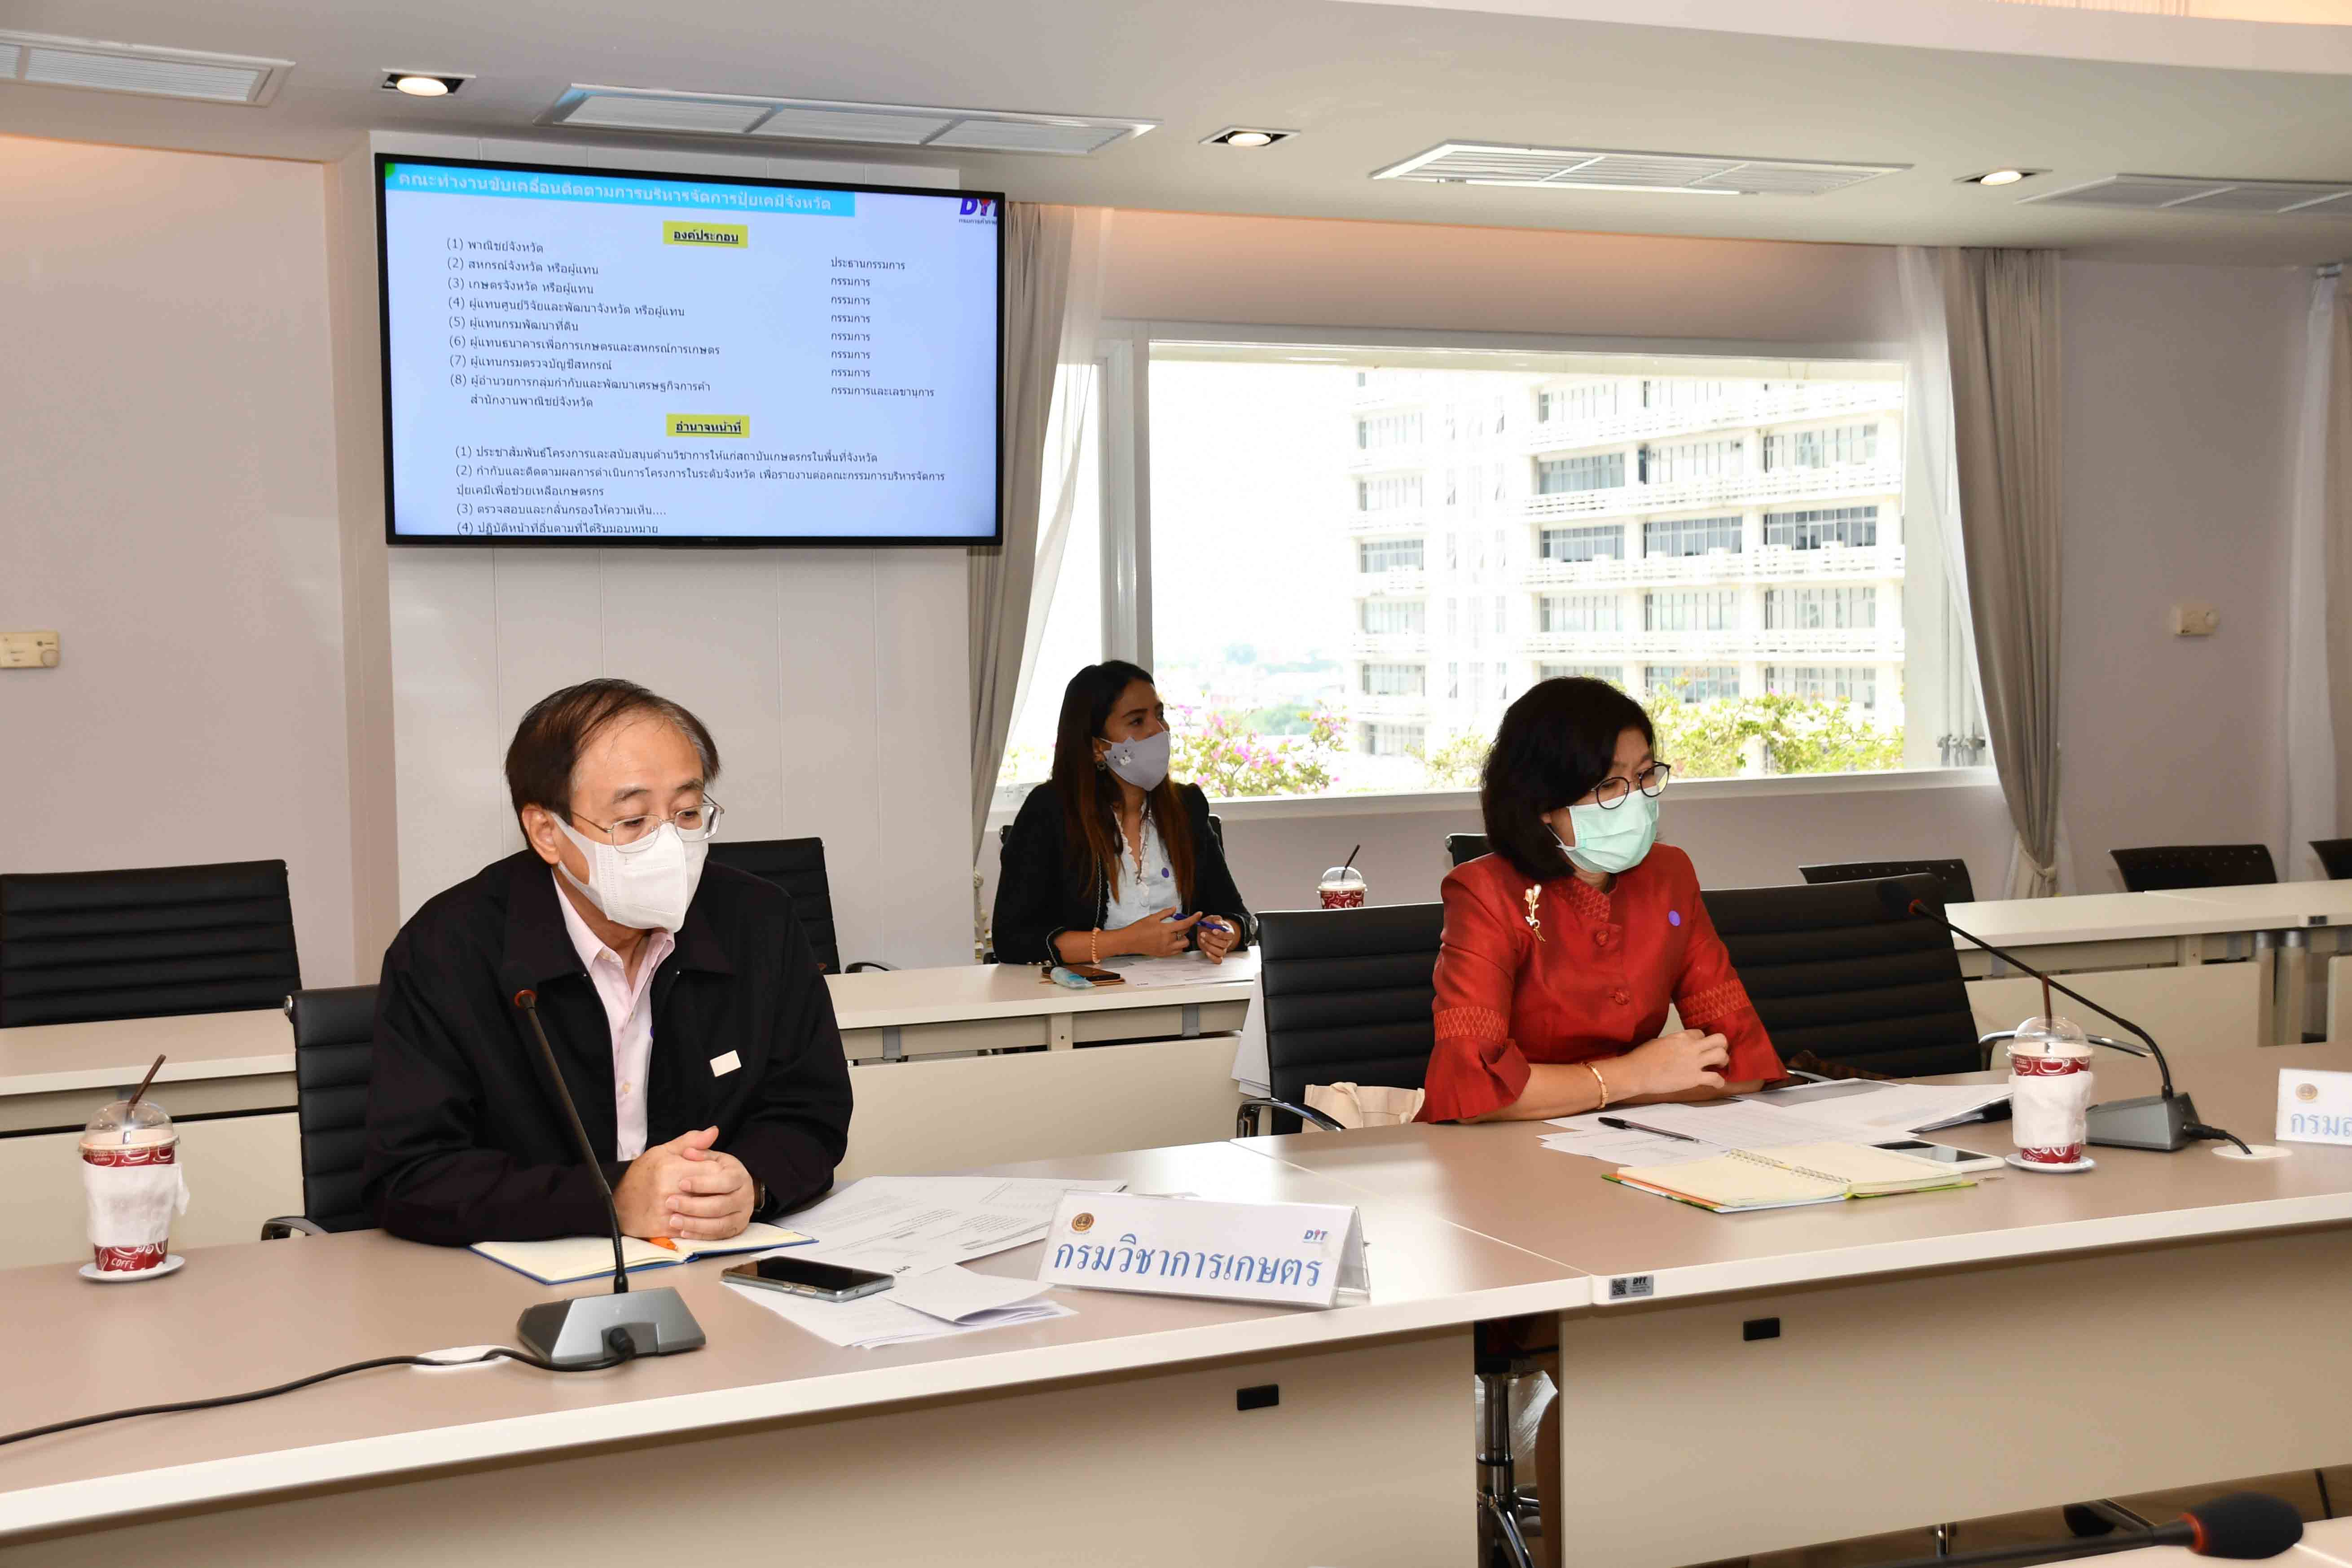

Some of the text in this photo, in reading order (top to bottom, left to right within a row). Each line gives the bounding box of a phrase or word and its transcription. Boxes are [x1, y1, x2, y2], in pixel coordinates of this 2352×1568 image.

[673, 229, 739, 244] องค์ประกอบ
[447, 237, 544, 254] (1) พาณิชย์จังหวัด
[447, 257, 598, 277] (2) สหกรณ์จังหวัด หรือผู้แทน
[831, 256, 906, 270] ประธานกรรมการ
[448, 277, 593, 295] (3) เกษตรจังหวัด หรือผู้แทน
[831, 277, 870, 287] กรรมการ
[448, 297, 685, 318] (4) ผู้แทนศูนย์วิจัยและพัฒนาจังหวัด หรือผู้แทน
[831, 296, 871, 306] กรรมการ
[449, 316, 579, 331] (5) ผู้แทนกรมพัฒนาที่ดิน
[831, 314, 870, 324] กรรมการ
[449, 334, 720, 355] (6) ผู้แทนธนาคารเพื่อการเกษตรและสหกรณ์การเกษตร
[831, 333, 870, 342] กรรมการ
[450, 354, 612, 371] (7) ผู้แทนกรมตรวจบัญชีสหกรณ์
[831, 351, 870, 360] กรรมการ
[450, 373, 467, 387] (8)
[831, 369, 870, 378] กรรมการ
[831, 387, 934, 399] กรรมการและเลขานุการ
[470, 393, 593, 408] สำนักงานพาณิชย์จังหวัด
[676, 419, 742, 434] อำนาจหน้าที่
[455, 445, 472, 459] (1)
[456, 464, 472, 478] (2)
[456, 481, 604, 497] ปุ๋ยเคมีเพื่อช่วยเหลือเกษตรกร
[457, 503, 473, 516] (3)
[457, 522, 473, 535] (4)
[1054, 1233, 1323, 1287] กรมวิชาการเกษตร
